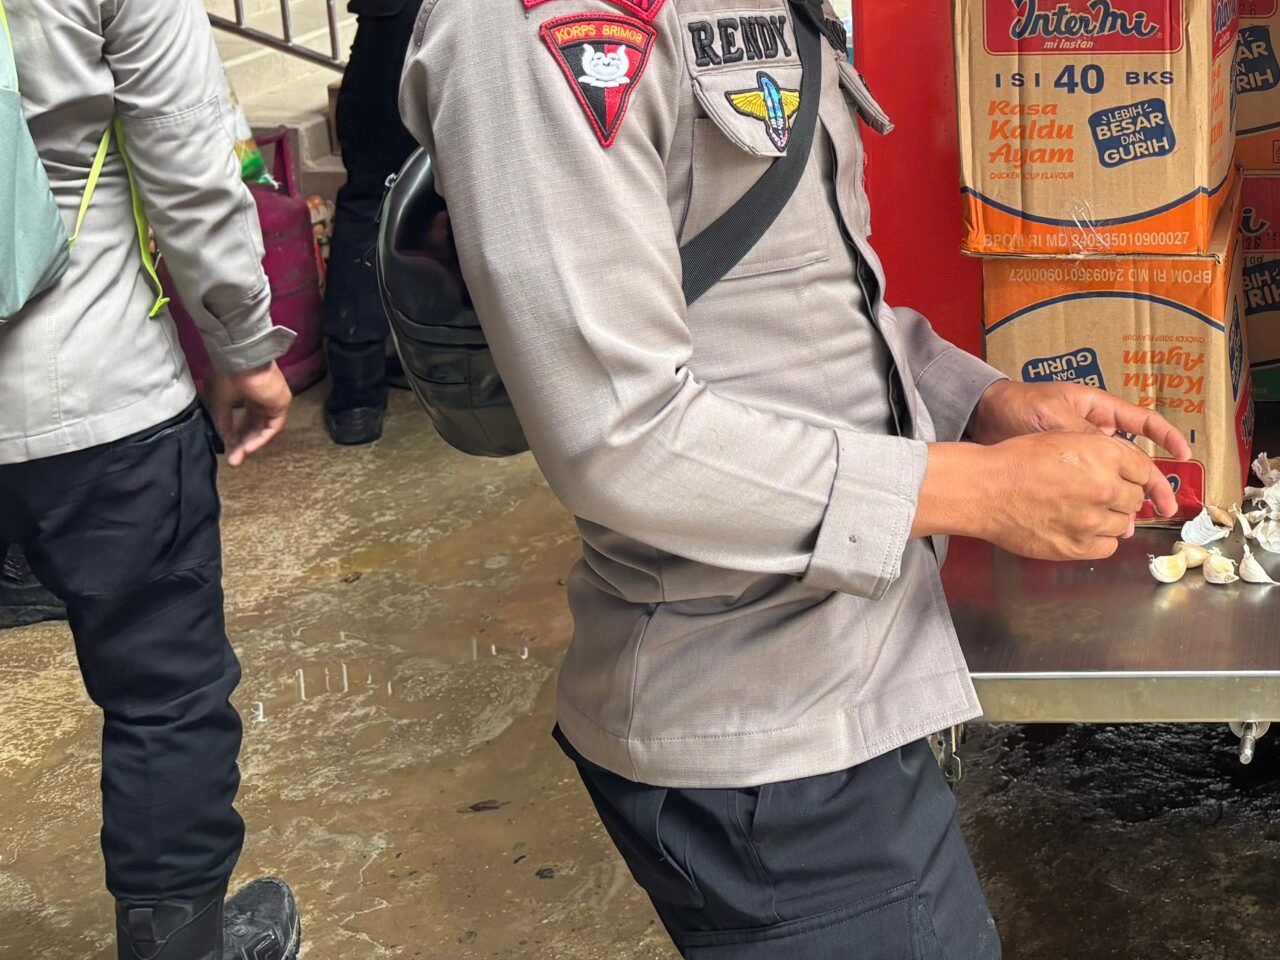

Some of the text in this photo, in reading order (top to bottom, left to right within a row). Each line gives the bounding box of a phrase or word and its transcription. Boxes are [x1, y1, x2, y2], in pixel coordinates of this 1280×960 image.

[555, 24, 643, 44] KORPS BRIMOB
[688, 15, 792, 67] RENDY
[1044, 39, 1093, 49] mi instan
[1053, 64, 1105, 95] 40
[1125, 71, 1174, 86] BKS
[1237, 69, 1275, 91] RIH
[987, 99, 1058, 116] Rasa
[1108, 106, 1142, 123] LEBIH
[987, 120, 1074, 140] Kaldu
[1096, 113, 1165, 140] BESAR
[1120, 131, 1145, 144] DAN
[987, 142, 1075, 169] Ayam
[1103, 136, 1170, 165] GURIH
[1022, 172, 1040, 180] OUP
[1041, 172, 1075, 180] FLAVOUR
[983, 233, 1026, 248] BPOM
[1029, 232, 1043, 247] RI
[1046, 232, 1068, 247] MD
[1129, 269, 1150, 283] MD
[1153, 269, 1167, 283] RI
[1171, 269, 1212, 284] BPOM
[1122, 334, 1204, 344] CHICKEN SOUP FLAVOUR
[1027, 351, 1093, 379] GURIH
[1122, 346, 1205, 372] Ayam
[1052, 369, 1076, 381] DAN
[1122, 373, 1205, 395] Kaldu
[1138, 396, 1205, 415] Rasa
